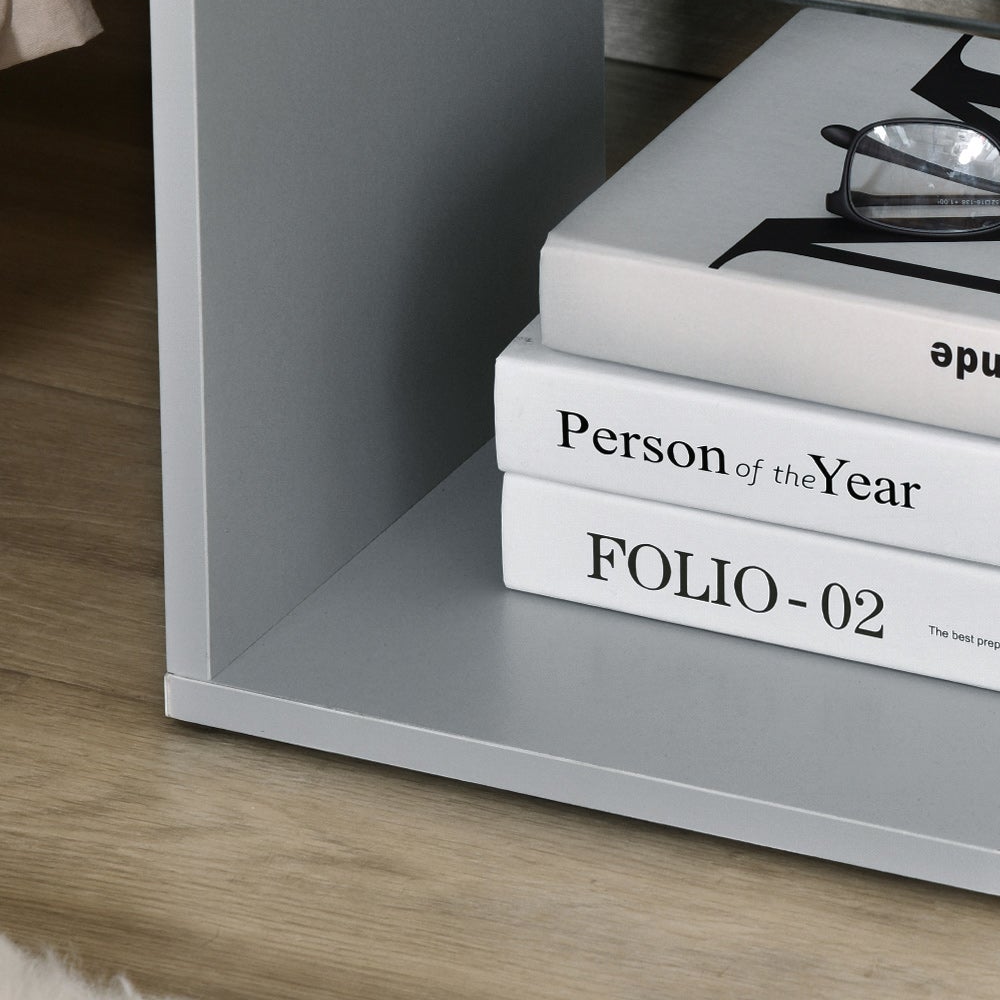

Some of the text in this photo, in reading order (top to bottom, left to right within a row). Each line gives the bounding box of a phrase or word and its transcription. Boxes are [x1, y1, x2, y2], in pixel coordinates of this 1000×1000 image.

[556, 409, 922, 510] Person of the Year
[586, 531, 778, 614] FOLIO
[821, 582, 884, 639] 02
[928, 625, 949, 638] The
[951, 630, 975, 644] best
